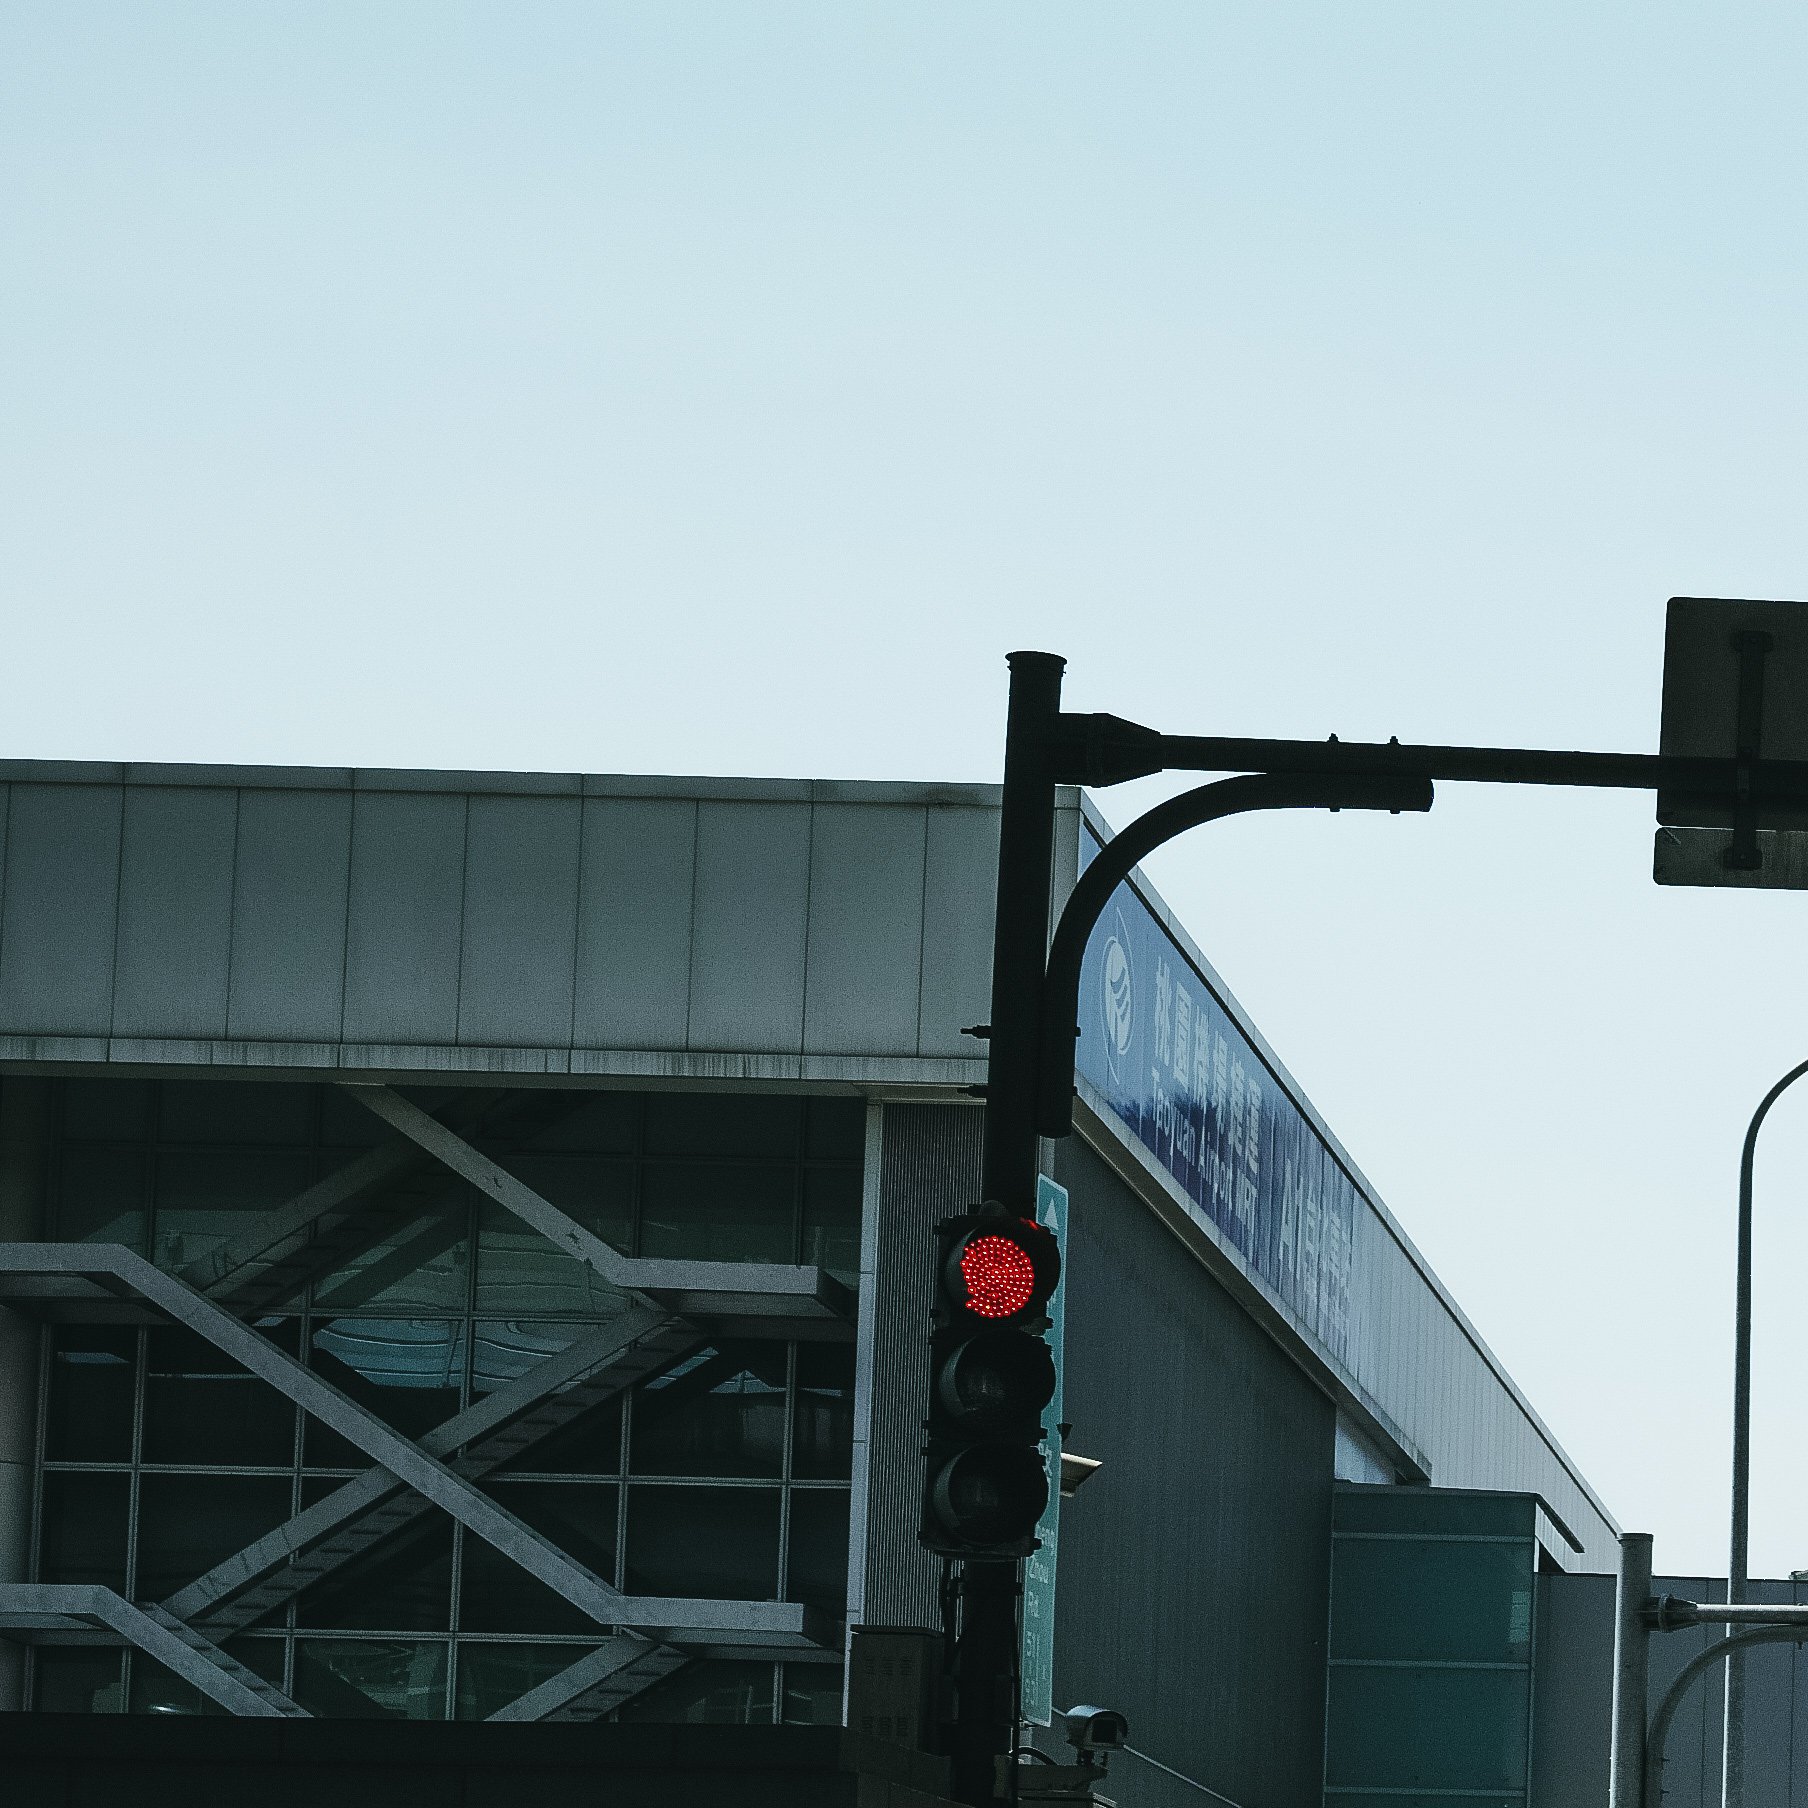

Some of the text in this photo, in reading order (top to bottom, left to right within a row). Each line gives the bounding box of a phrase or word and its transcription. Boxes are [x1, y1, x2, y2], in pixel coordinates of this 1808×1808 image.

[1151, 1067, 1258, 1234] Taoyuan Airport MRT
